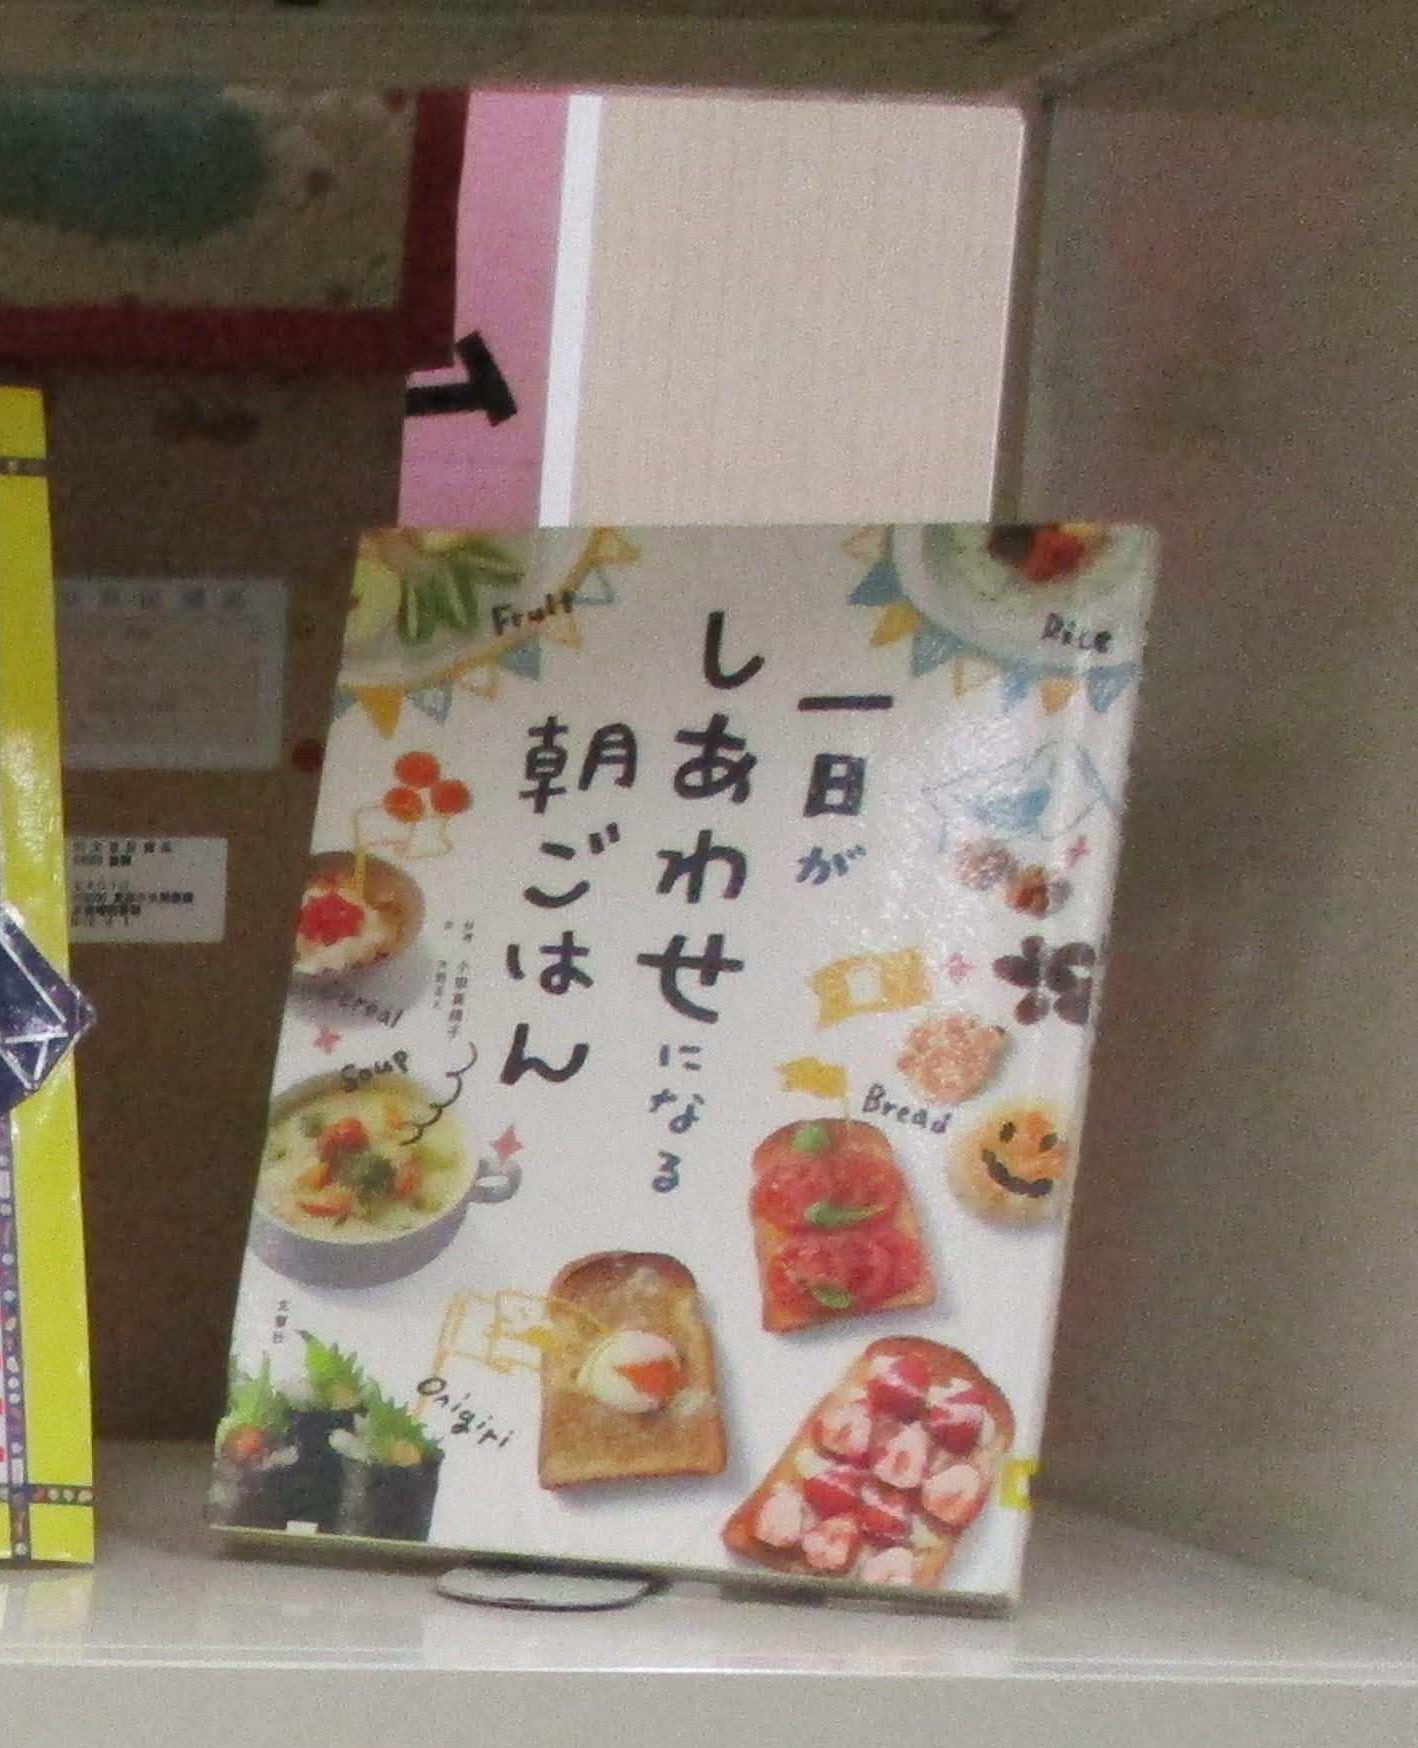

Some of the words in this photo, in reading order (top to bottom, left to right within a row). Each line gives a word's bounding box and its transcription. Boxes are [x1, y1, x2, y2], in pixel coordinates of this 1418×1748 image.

[492, 590, 578, 635] Fruit
[1041, 611, 1111, 654] Rice
[796, 692, 895, 888] 一日が
[501, 714, 639, 1086] 朝ごはん
[636, 610, 764, 1194] しあわせになる
[340, 1048, 410, 1094] Soup
[861, 1083, 953, 1136] Bread
[415, 1374, 516, 1450] Onigiri
